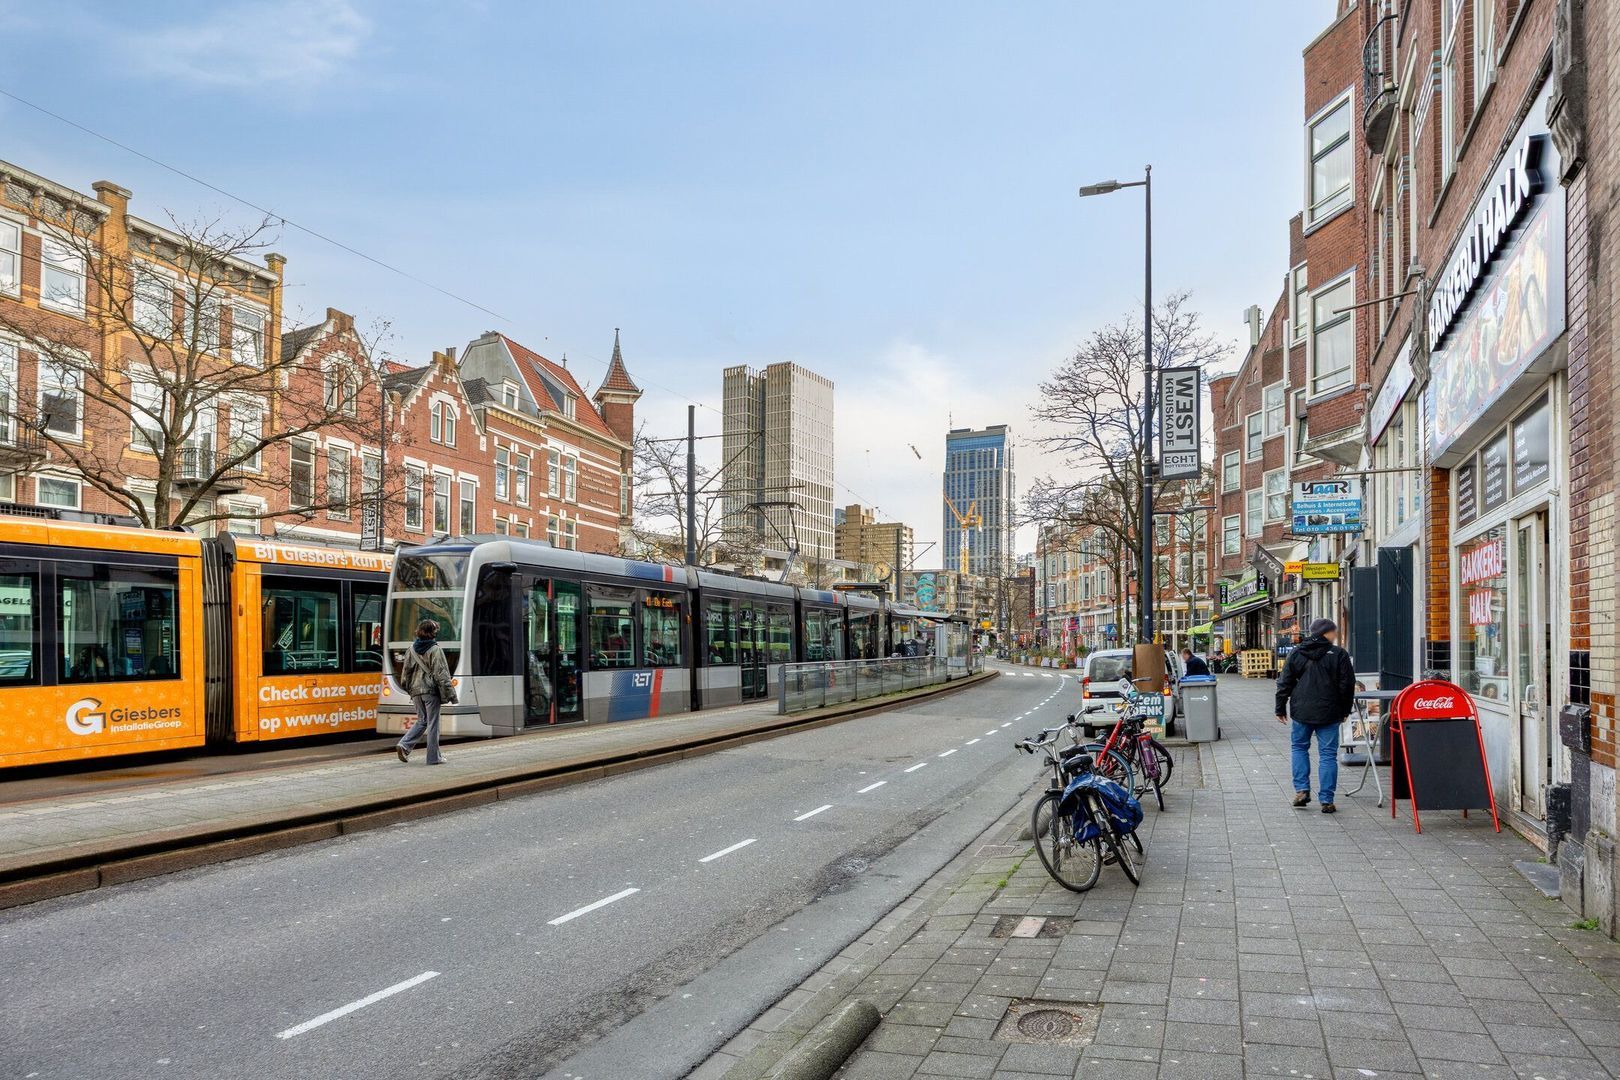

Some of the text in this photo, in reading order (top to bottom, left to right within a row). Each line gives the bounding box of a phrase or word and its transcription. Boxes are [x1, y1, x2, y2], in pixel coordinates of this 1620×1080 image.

[1428, 135, 1532, 353] BAKKERIJ HALK
[1165, 378, 1174, 447] KRUISKADE
[1164, 454, 1196, 464] ECHT
[282, 546, 349, 566] Giesbers
[350, 554, 378, 569] kun
[1461, 539, 1502, 585] BAKKERIJ
[425, 566, 434, 579] 11
[1469, 590, 1492, 624] HALK
[632, 672, 652, 688] RET
[260, 685, 308, 702] Check
[311, 686, 346, 699] onze
[1413, 696, 1455, 710] Coca-Cola
[110, 706, 181, 723] Giesbers
[110, 720, 182, 733] InstallatieGroep
[260, 718, 281, 733] op
